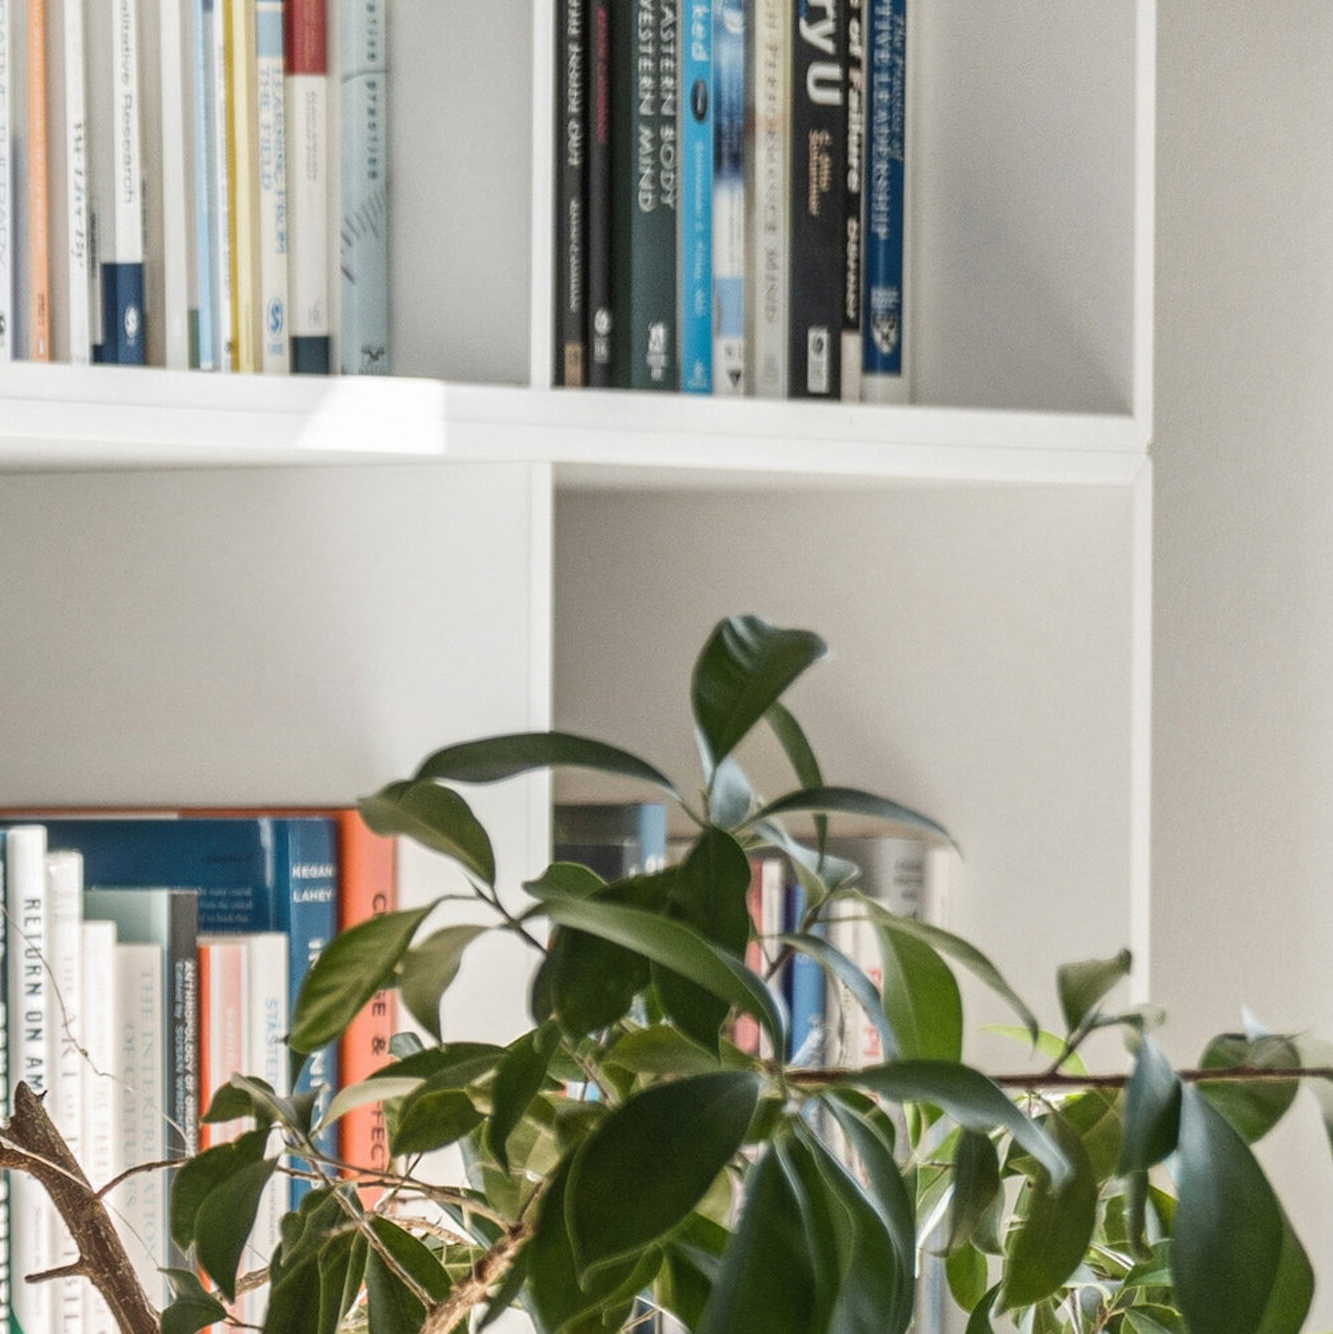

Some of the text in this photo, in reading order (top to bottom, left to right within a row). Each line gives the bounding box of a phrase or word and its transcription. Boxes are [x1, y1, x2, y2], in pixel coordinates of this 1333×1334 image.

[122, 94, 135, 205] Research
[637, 124, 655, 213] MIND
[659, 125, 676, 210] BODY
[291, 864, 334, 879] KEGAN
[293, 890, 334, 903] LAHEY
[23, 897, 43, 1042] RETURN ON
